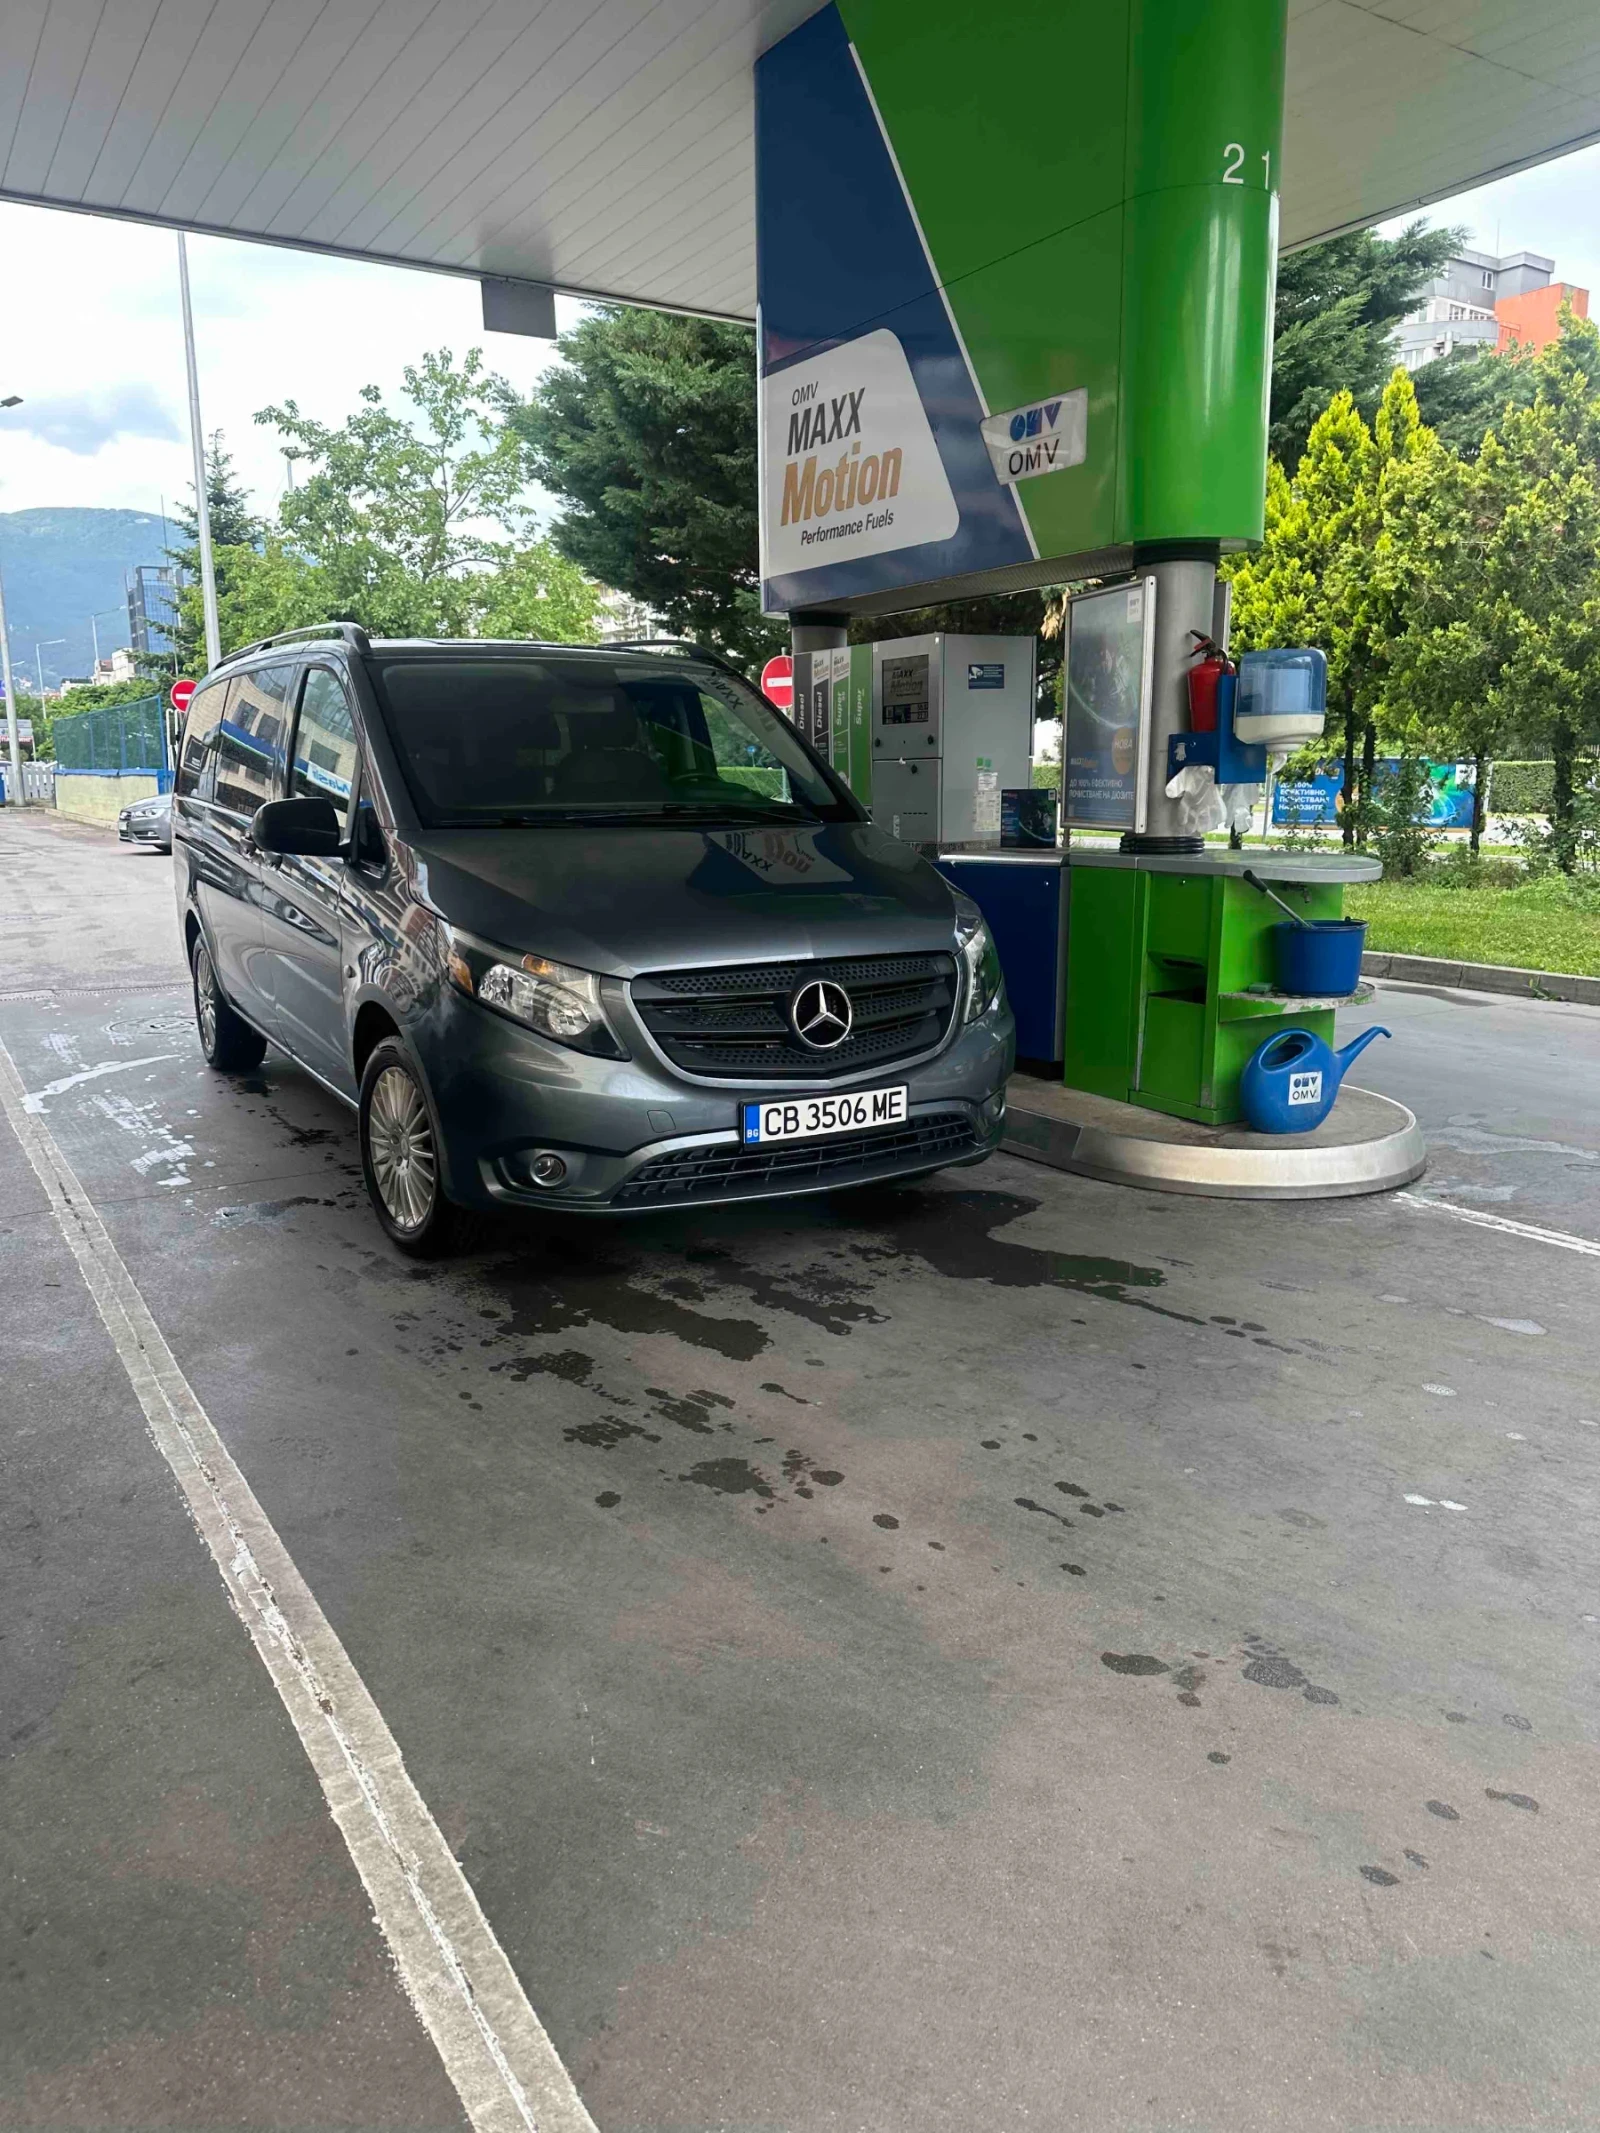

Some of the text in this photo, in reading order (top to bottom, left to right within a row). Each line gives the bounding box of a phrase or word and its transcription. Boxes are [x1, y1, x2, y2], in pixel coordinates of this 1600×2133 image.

[1223, 143, 1270, 190] 2 1
[792, 381, 819, 406] OMV
[787, 387, 865, 456] MAXX
[1009, 438, 1060, 475] OMV
[780, 441, 903, 527] Motion
[801, 508, 894, 546] Performance Fuels
[765, 1090, 902, 1136] CB 3506 ME
[1292, 1089, 1317, 1101] OMV
[747, 1129, 759, 1138] BG
